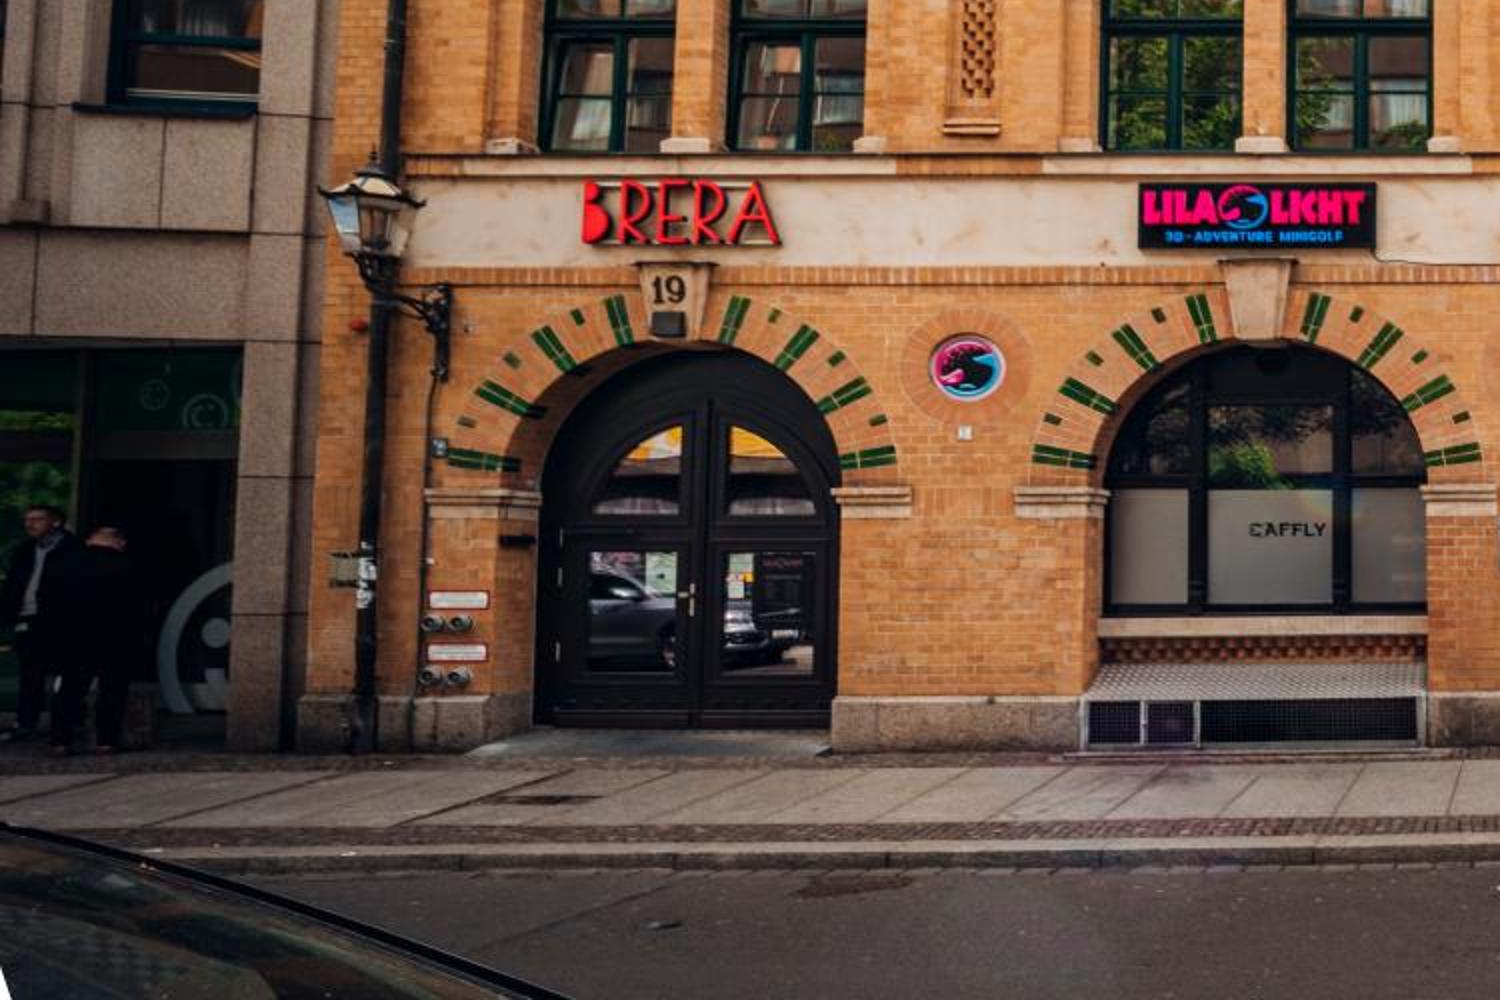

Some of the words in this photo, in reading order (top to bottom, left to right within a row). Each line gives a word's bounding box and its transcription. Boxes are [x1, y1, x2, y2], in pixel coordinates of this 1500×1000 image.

[582, 178, 781, 245] BRERA
[1143, 190, 1218, 224] LILA
[1269, 190, 1365, 224] LICHT
[1194, 231, 1273, 242] ADVENTURE
[1280, 231, 1344, 242] MINIGOLF
[651, 275, 686, 304] 19
